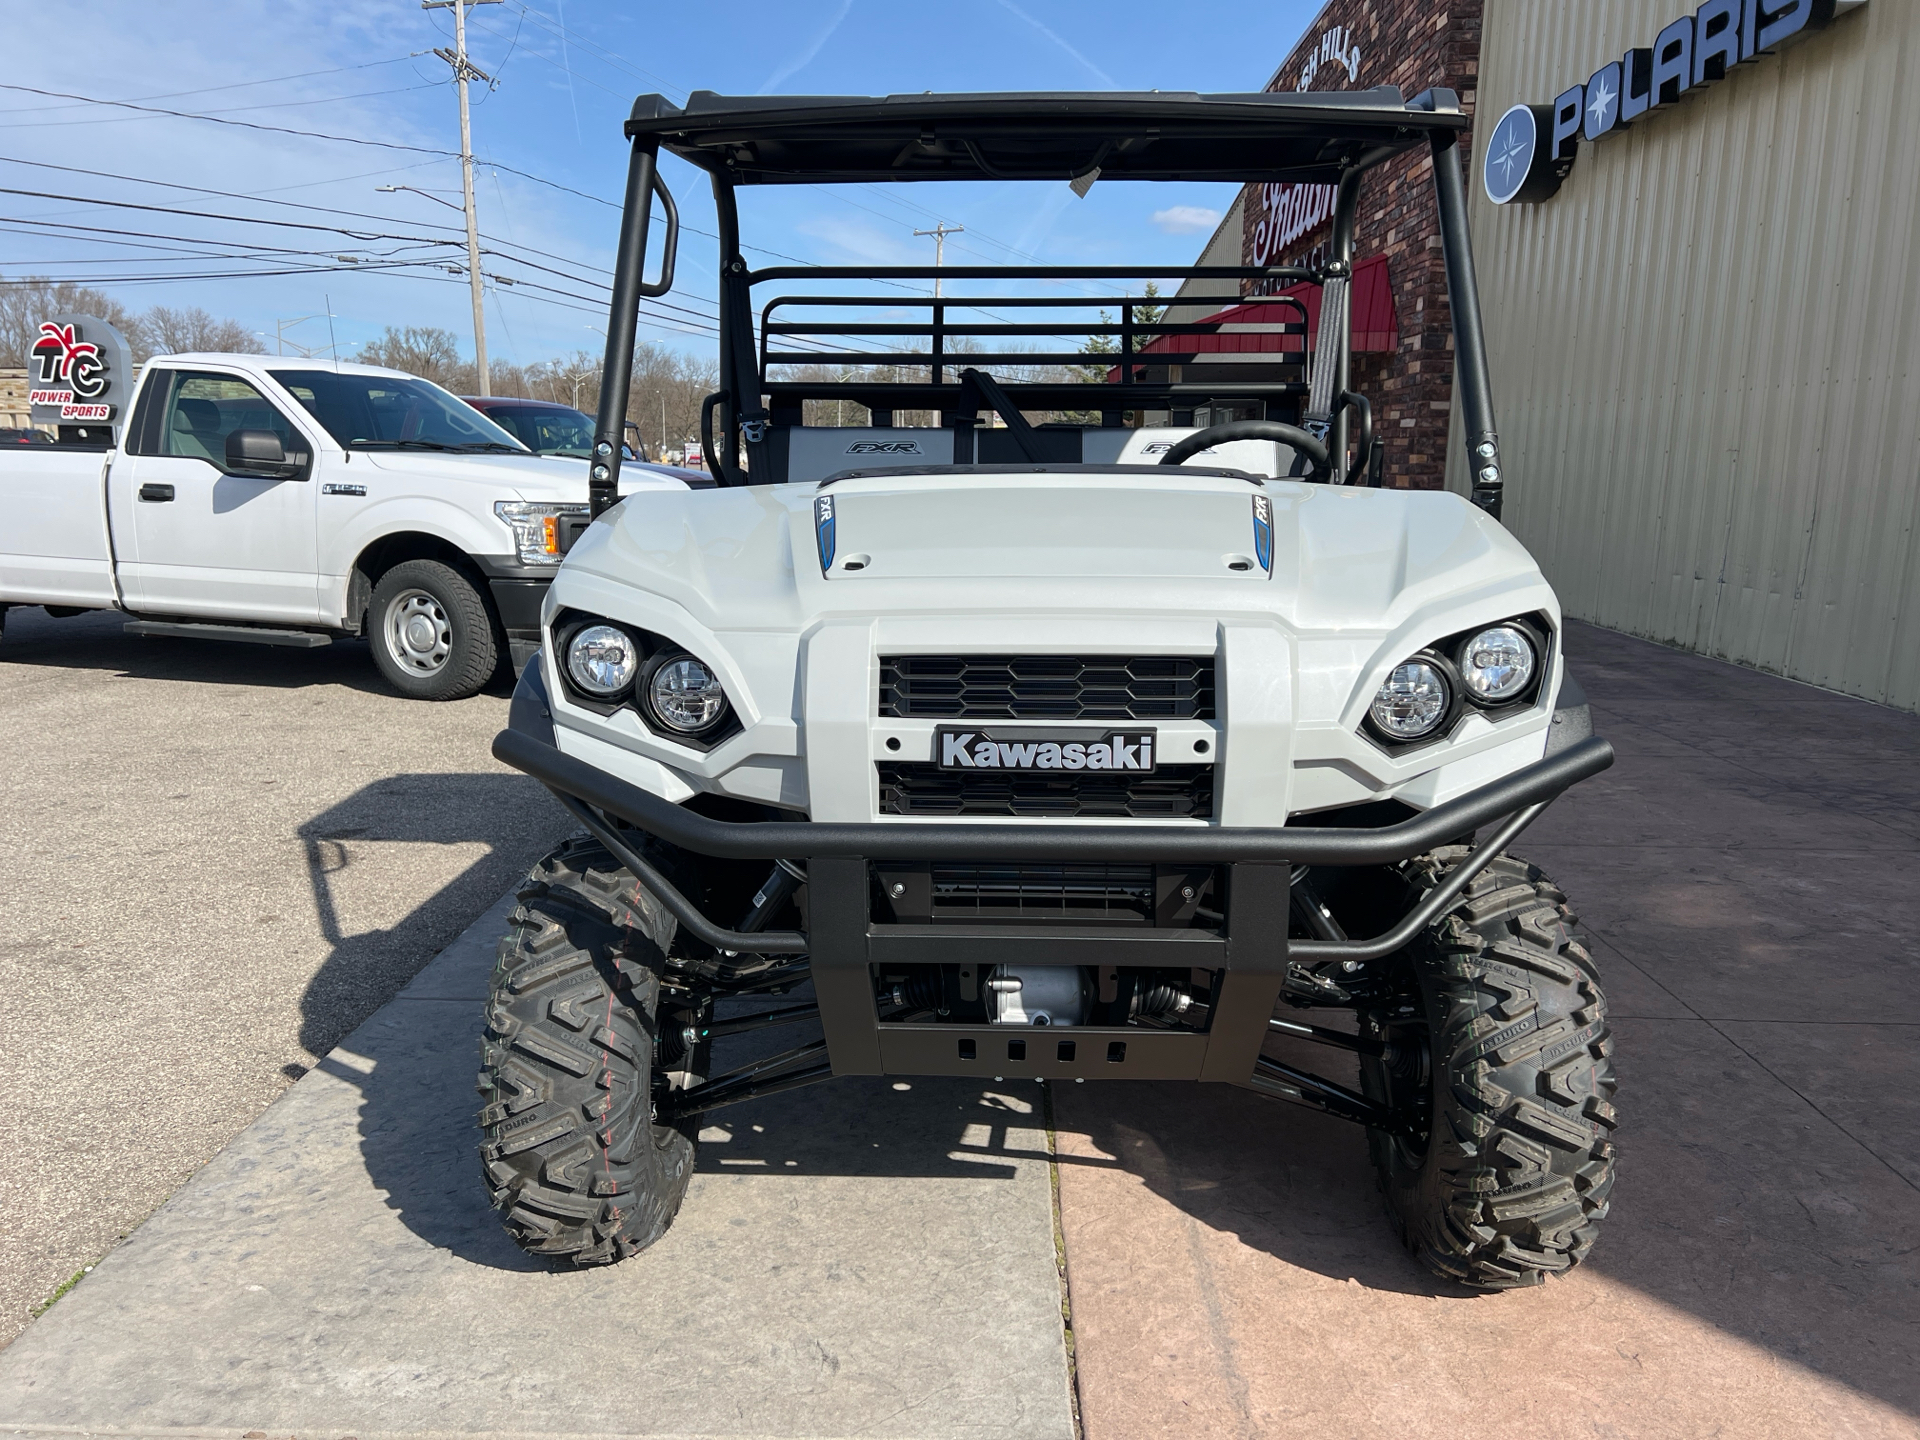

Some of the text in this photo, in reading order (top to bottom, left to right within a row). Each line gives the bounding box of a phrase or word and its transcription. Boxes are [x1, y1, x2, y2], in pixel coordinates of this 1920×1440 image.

[30, 391, 72, 403] POWER
[62, 404, 108, 418] SPORTS
[846, 441, 921, 454] FXR
[820, 496, 832, 522] FXR
[1254, 495, 1268, 525] FXR
[942, 732, 1152, 770] Kawasaki
